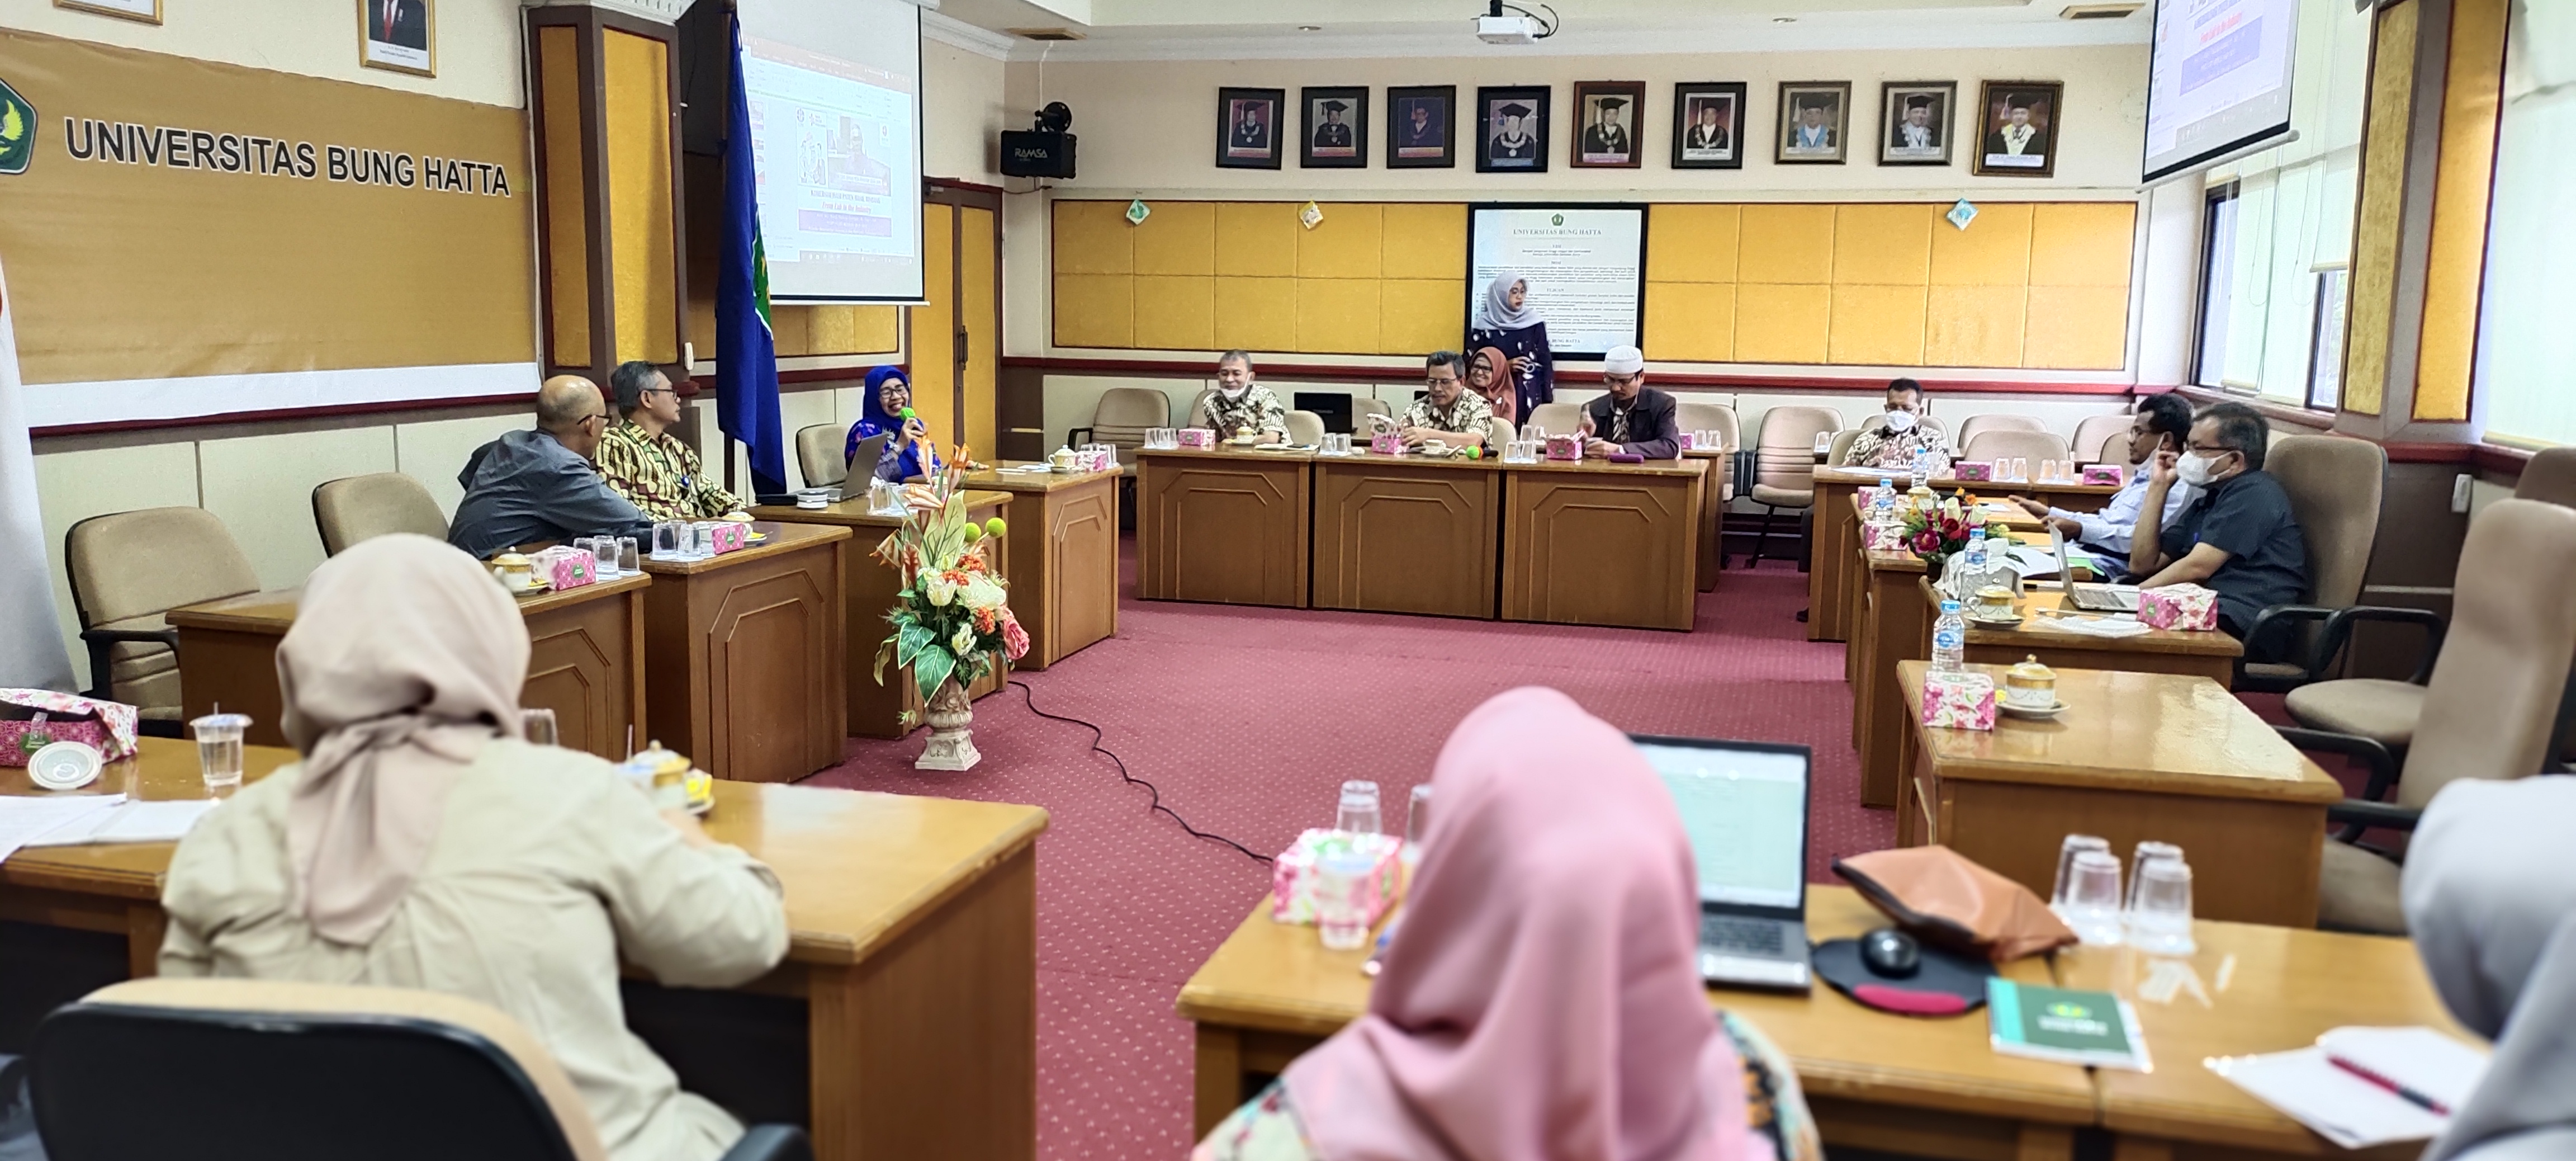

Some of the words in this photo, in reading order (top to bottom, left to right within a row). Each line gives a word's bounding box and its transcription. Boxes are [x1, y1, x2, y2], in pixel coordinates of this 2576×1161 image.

[64, 116, 318, 180] UNIVERSITAS
[326, 144, 415, 188] BUNG
[423, 155, 512, 197] HATTA
[1015, 148, 1048, 158] RAMSA
